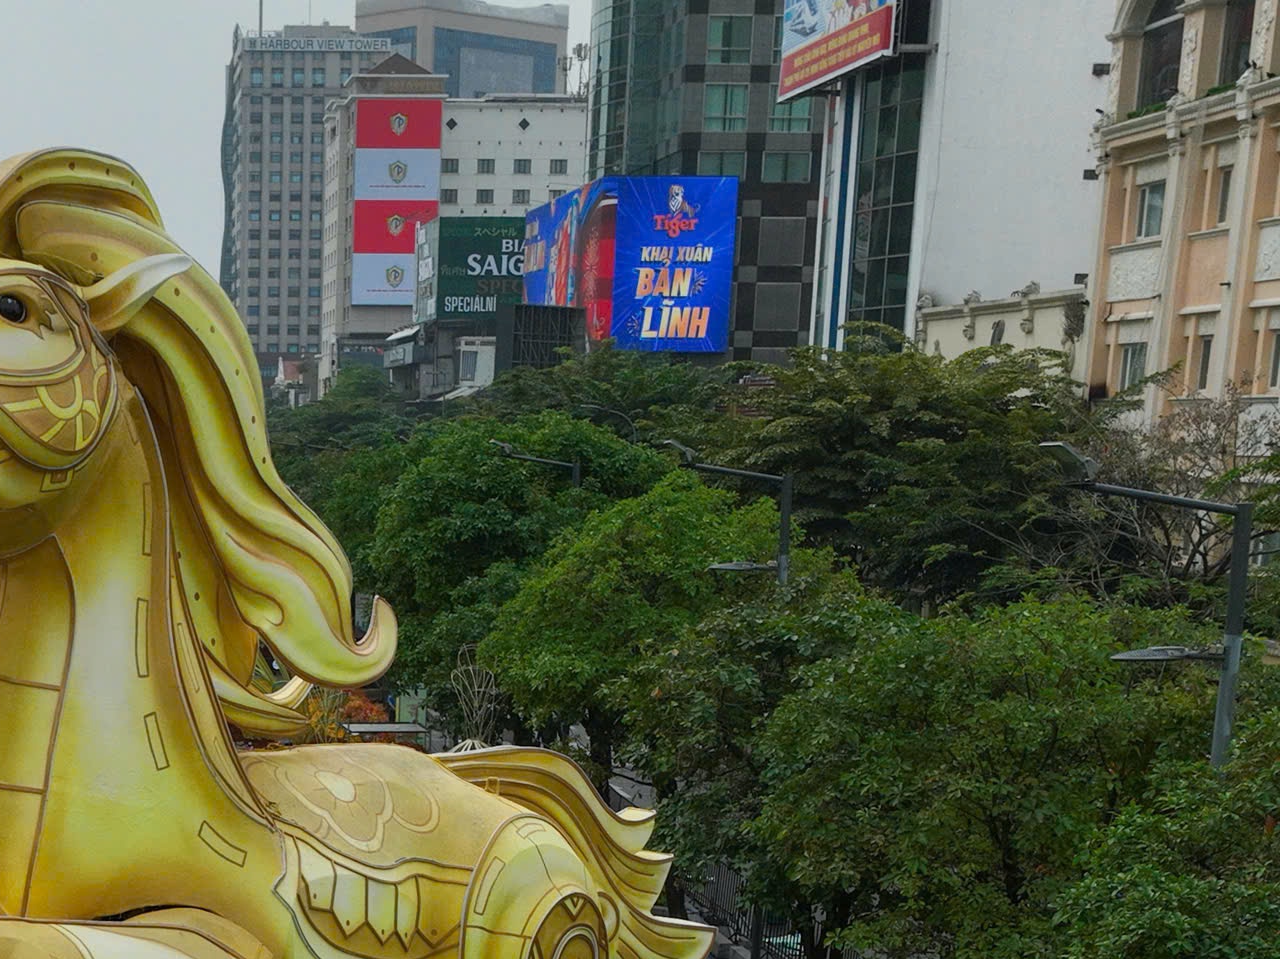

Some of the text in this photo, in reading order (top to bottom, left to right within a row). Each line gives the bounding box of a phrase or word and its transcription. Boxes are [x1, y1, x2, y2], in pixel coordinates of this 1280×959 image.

[260, 39, 388, 50] HARBOUR VIEW TOWER
[653, 213, 699, 237] Tiger
[640, 243, 714, 262] KHAI XUÂN
[466, 253, 525, 276] SAIG
[634, 258, 693, 299] BẢN
[444, 294, 497, 312] SPECIÁLNÍ
[640, 299, 711, 338] LĨNH
